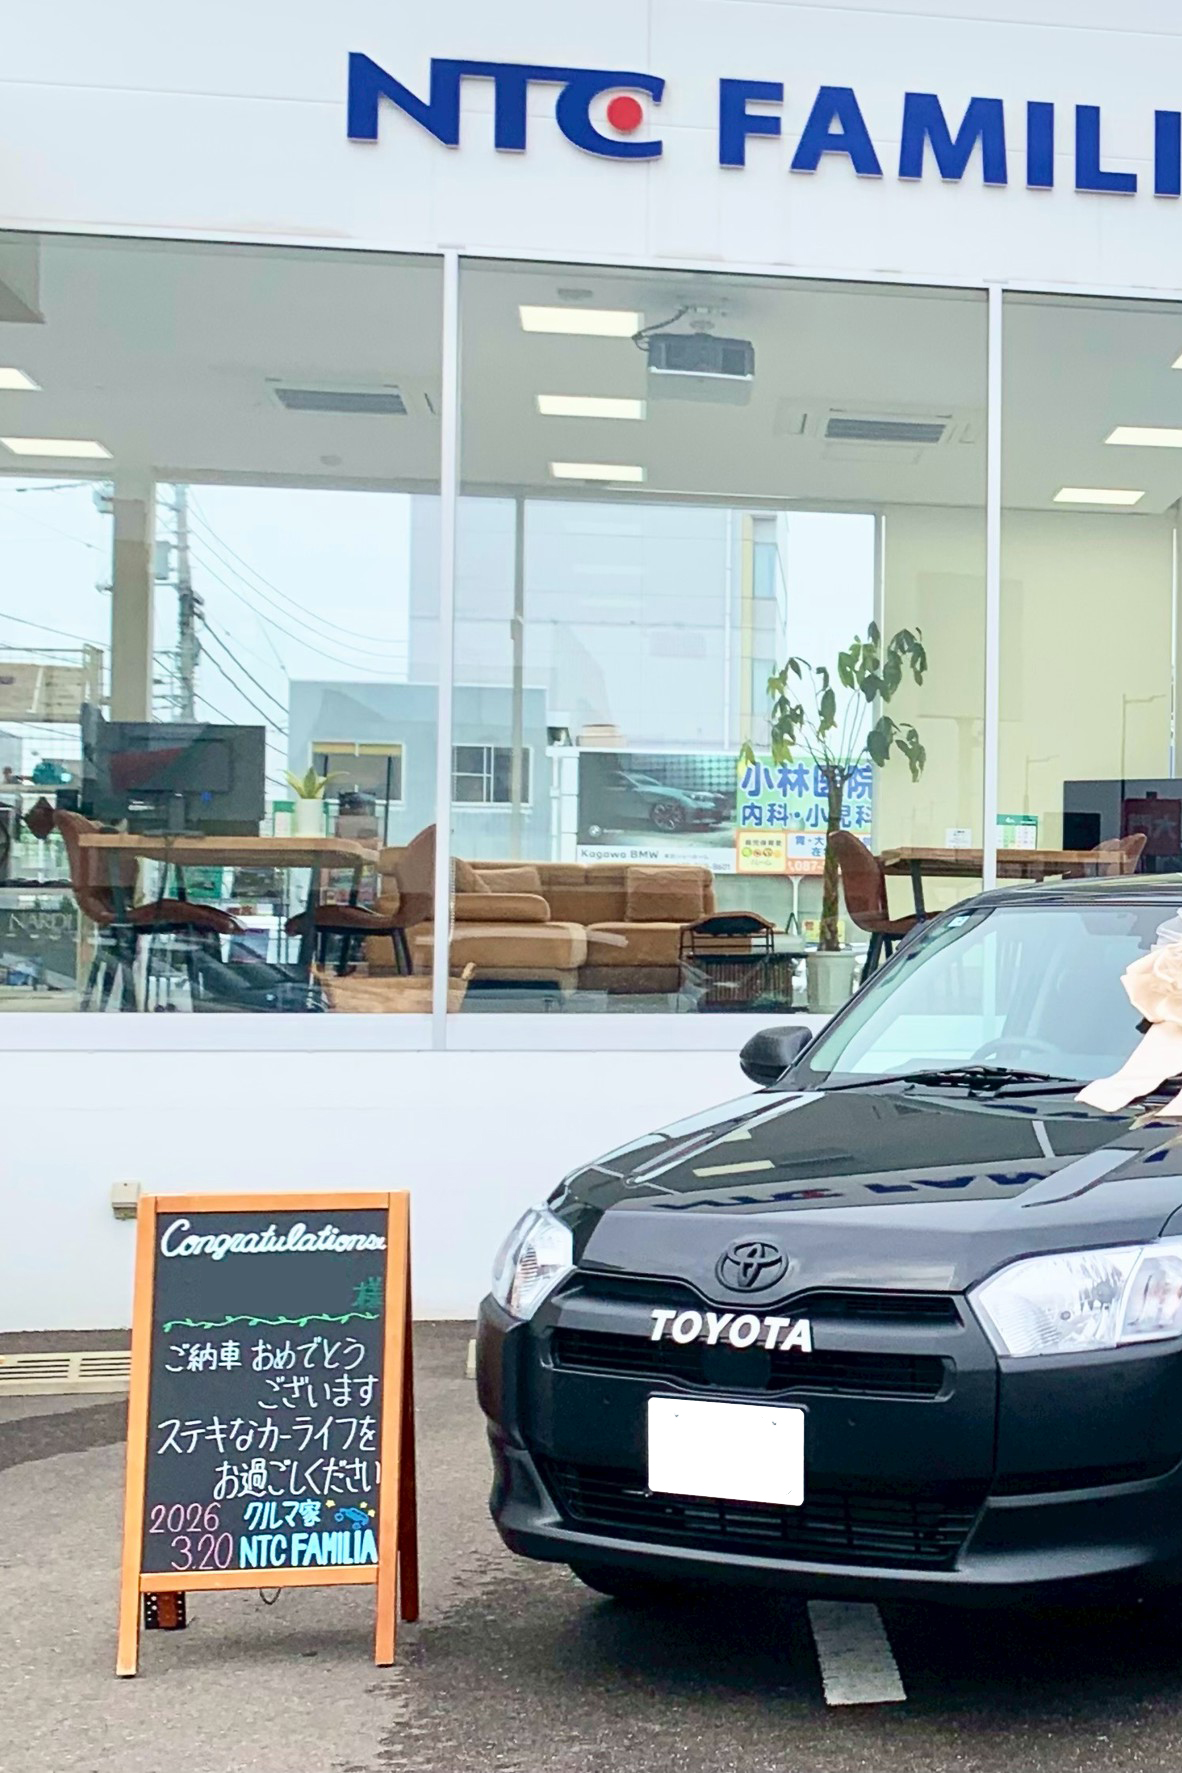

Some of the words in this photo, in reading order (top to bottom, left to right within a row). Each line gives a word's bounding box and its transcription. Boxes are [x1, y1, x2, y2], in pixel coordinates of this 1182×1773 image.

[347, 51, 667, 163] NTC
[630, 850, 659, 859] BMW
[161, 1218, 388, 1261] Congratulations
[650, 1308, 815, 1353] TOYOTA
[165, 1339, 242, 1372] ご納車
[250, 1336, 366, 1372] おめでとう
[258, 1373, 379, 1409] ございます
[157, 1415, 377, 1455] ステキなカーライフを
[213, 1457, 381, 1500] お過ごしください
[149, 1502, 222, 1534] 2026
[243, 1499, 322, 1531] クルマ家
[171, 1532, 234, 1571] 3.20
[239, 1536, 288, 1569] NTC
[291, 1528, 379, 1567] FAMILIA
